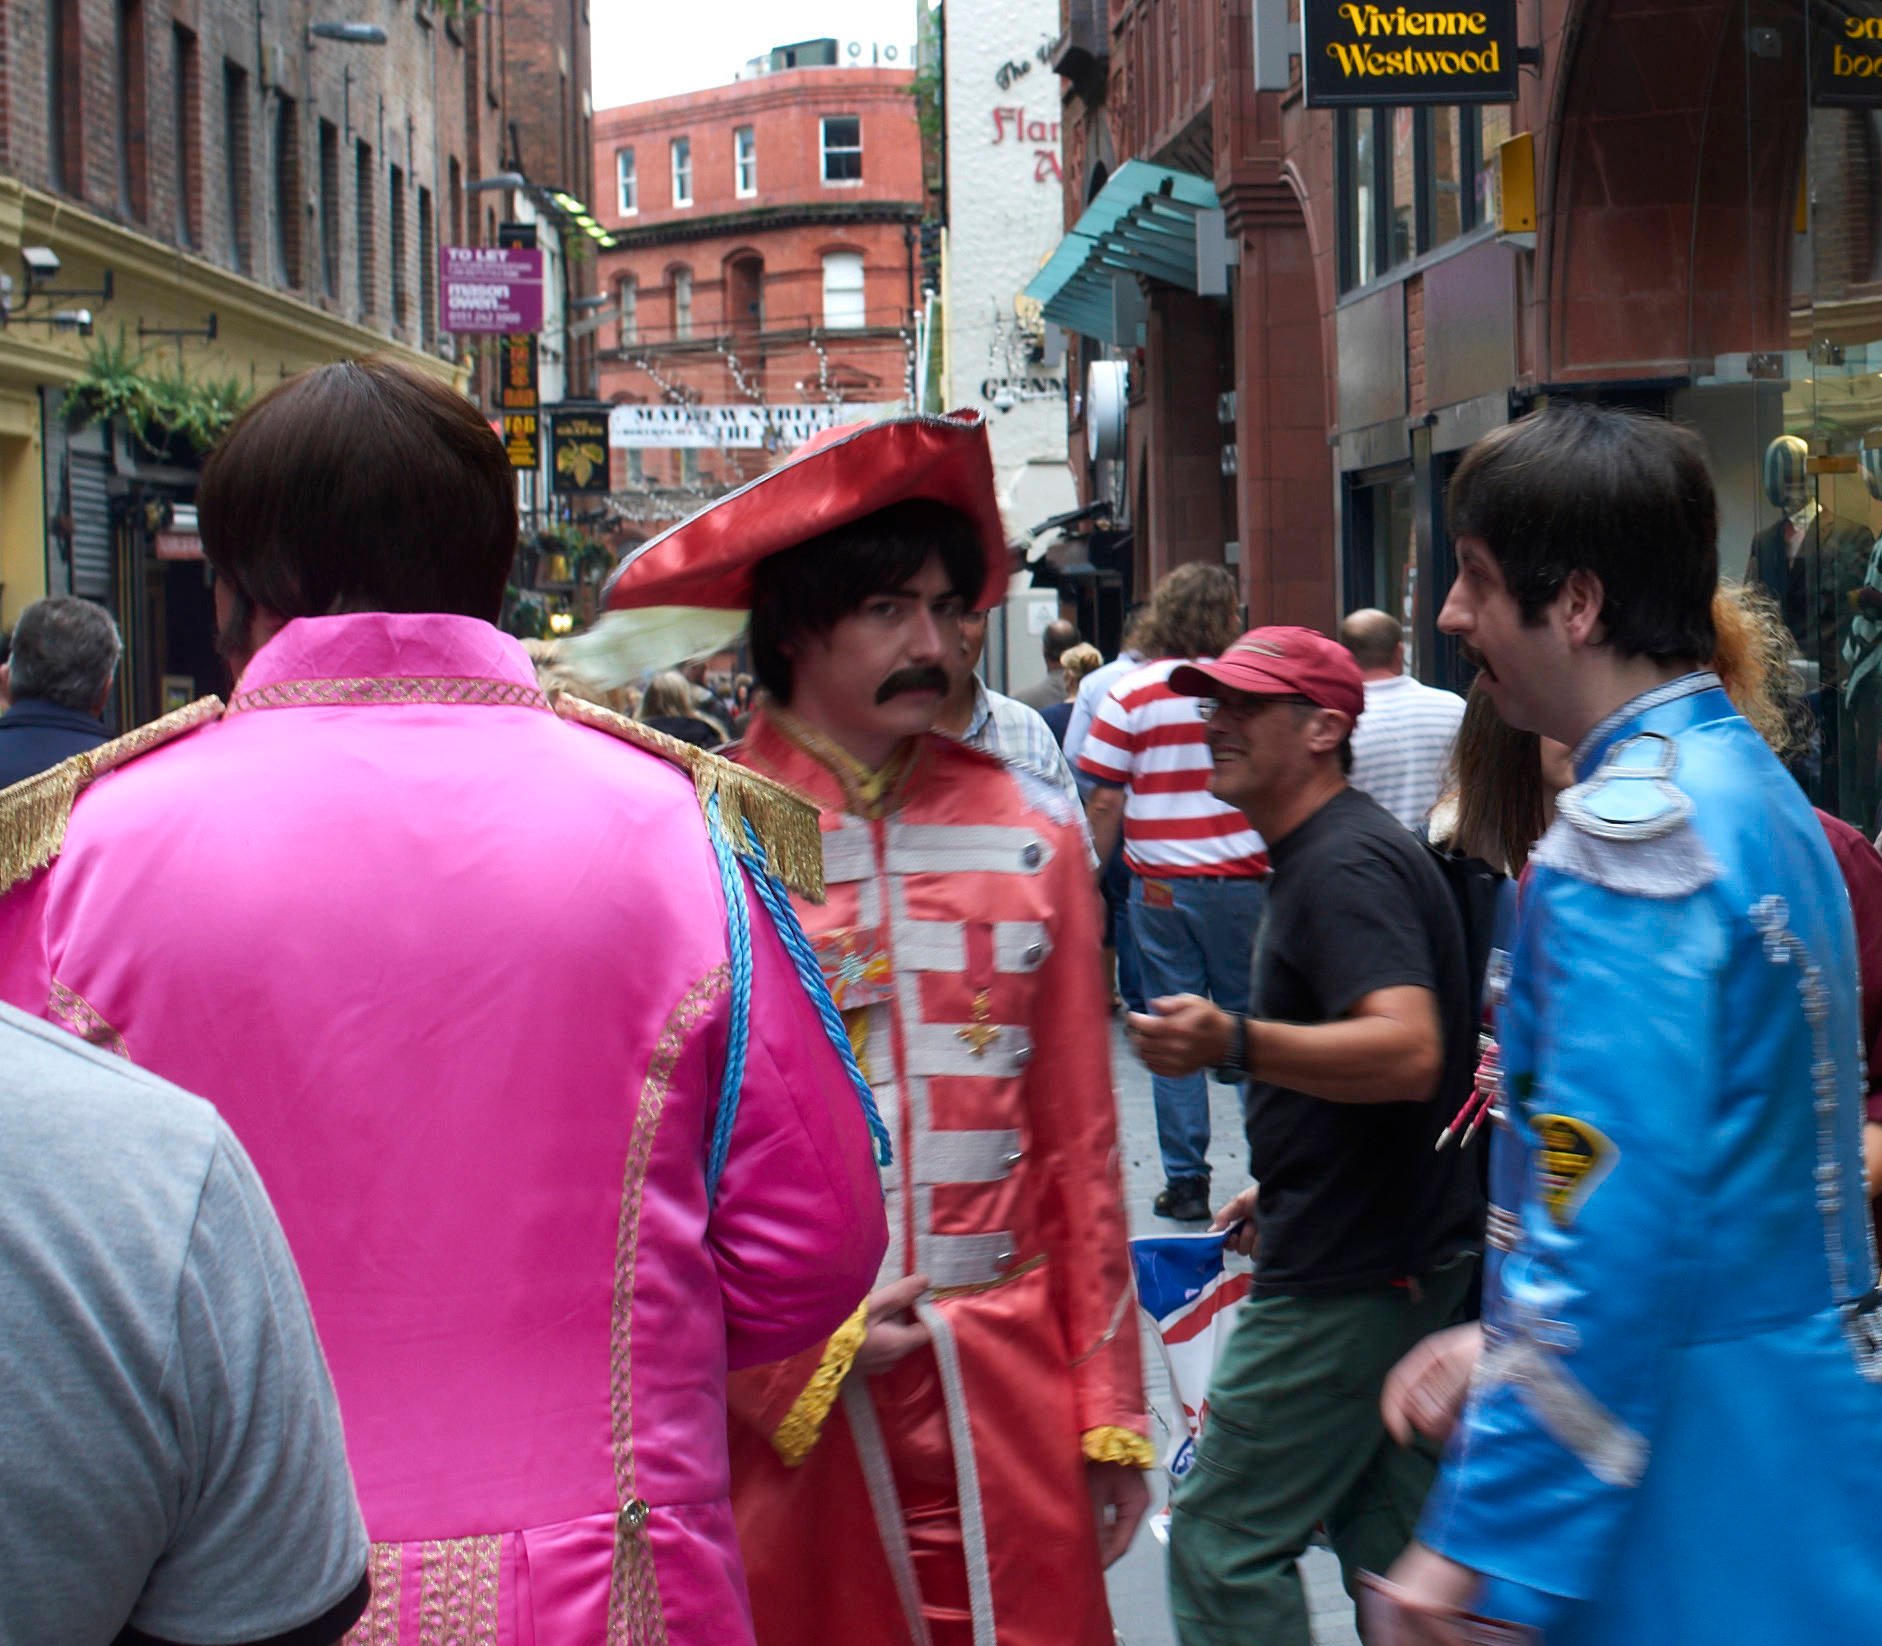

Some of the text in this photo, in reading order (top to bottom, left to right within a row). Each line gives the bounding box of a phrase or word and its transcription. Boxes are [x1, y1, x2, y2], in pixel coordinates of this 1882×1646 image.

[1338, 2, 1488, 37] Vivienne
[1326, 40, 1501, 78] Westwood
[448, 248, 509, 262] TO LET
